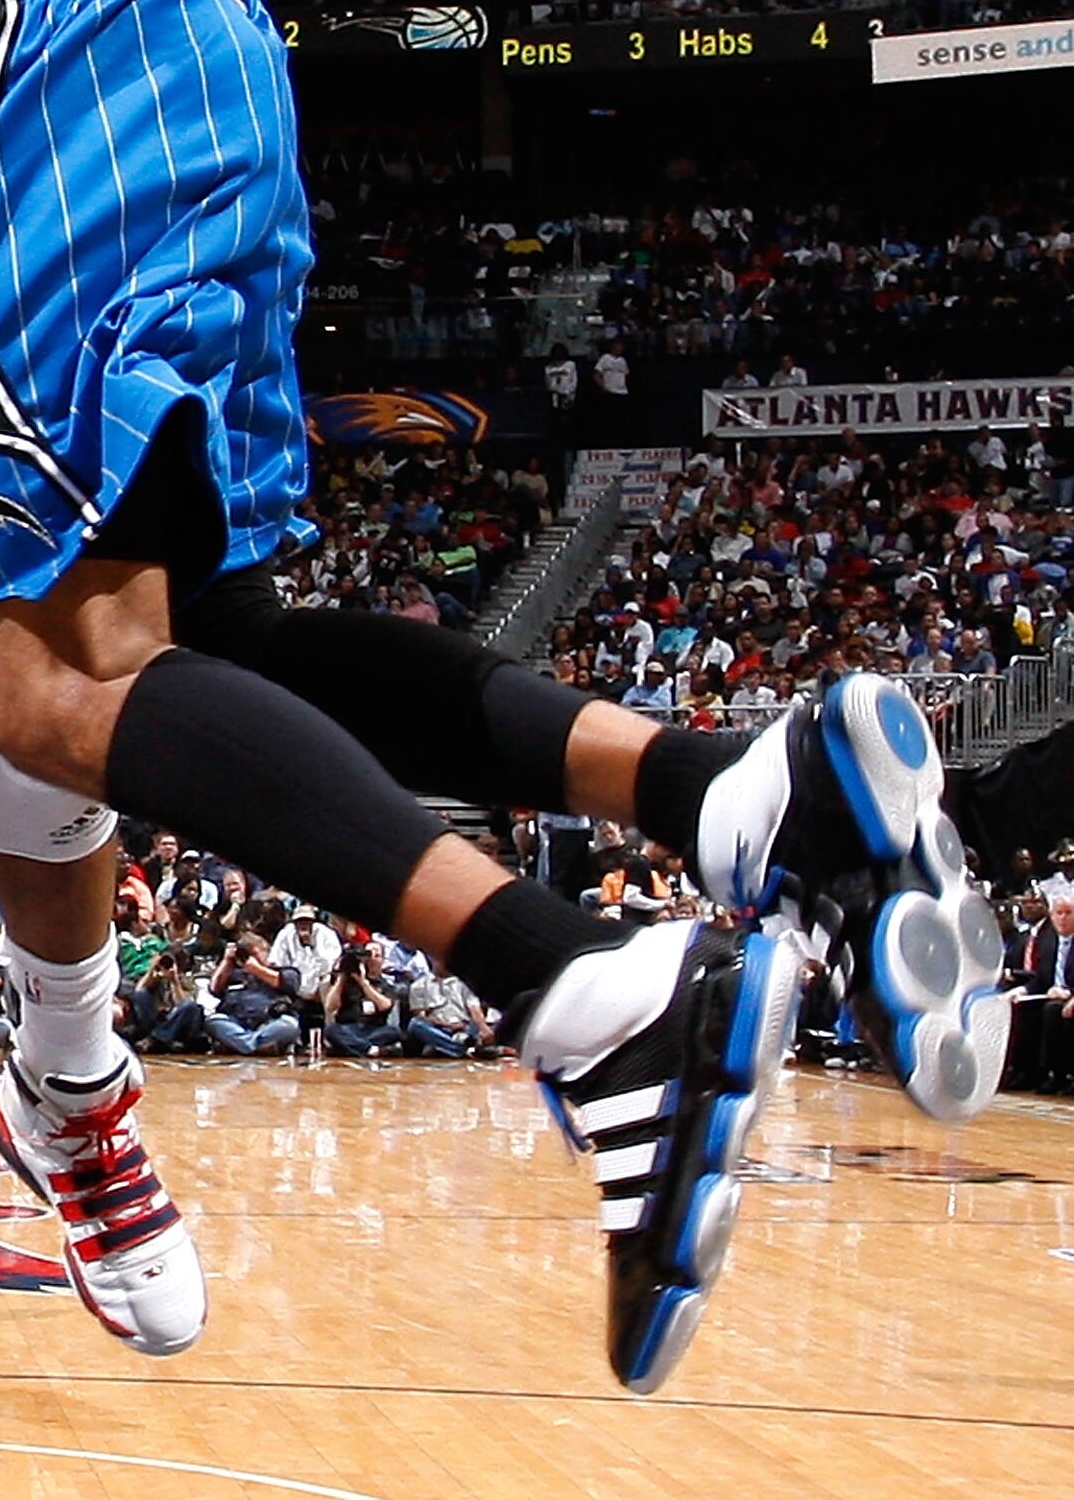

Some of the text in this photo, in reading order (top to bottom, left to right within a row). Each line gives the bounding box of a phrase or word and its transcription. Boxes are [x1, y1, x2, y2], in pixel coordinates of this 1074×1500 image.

[283, 21, 300, 47] 2
[502, 39, 572, 65] Pens
[629, 32, 645, 60] 3
[679, 28, 754, 57] Habs
[811, 22, 828, 49] 4
[917, 29, 1073, 67] sense and
[716, 386, 1073, 428] ATLANTA HAWKS
